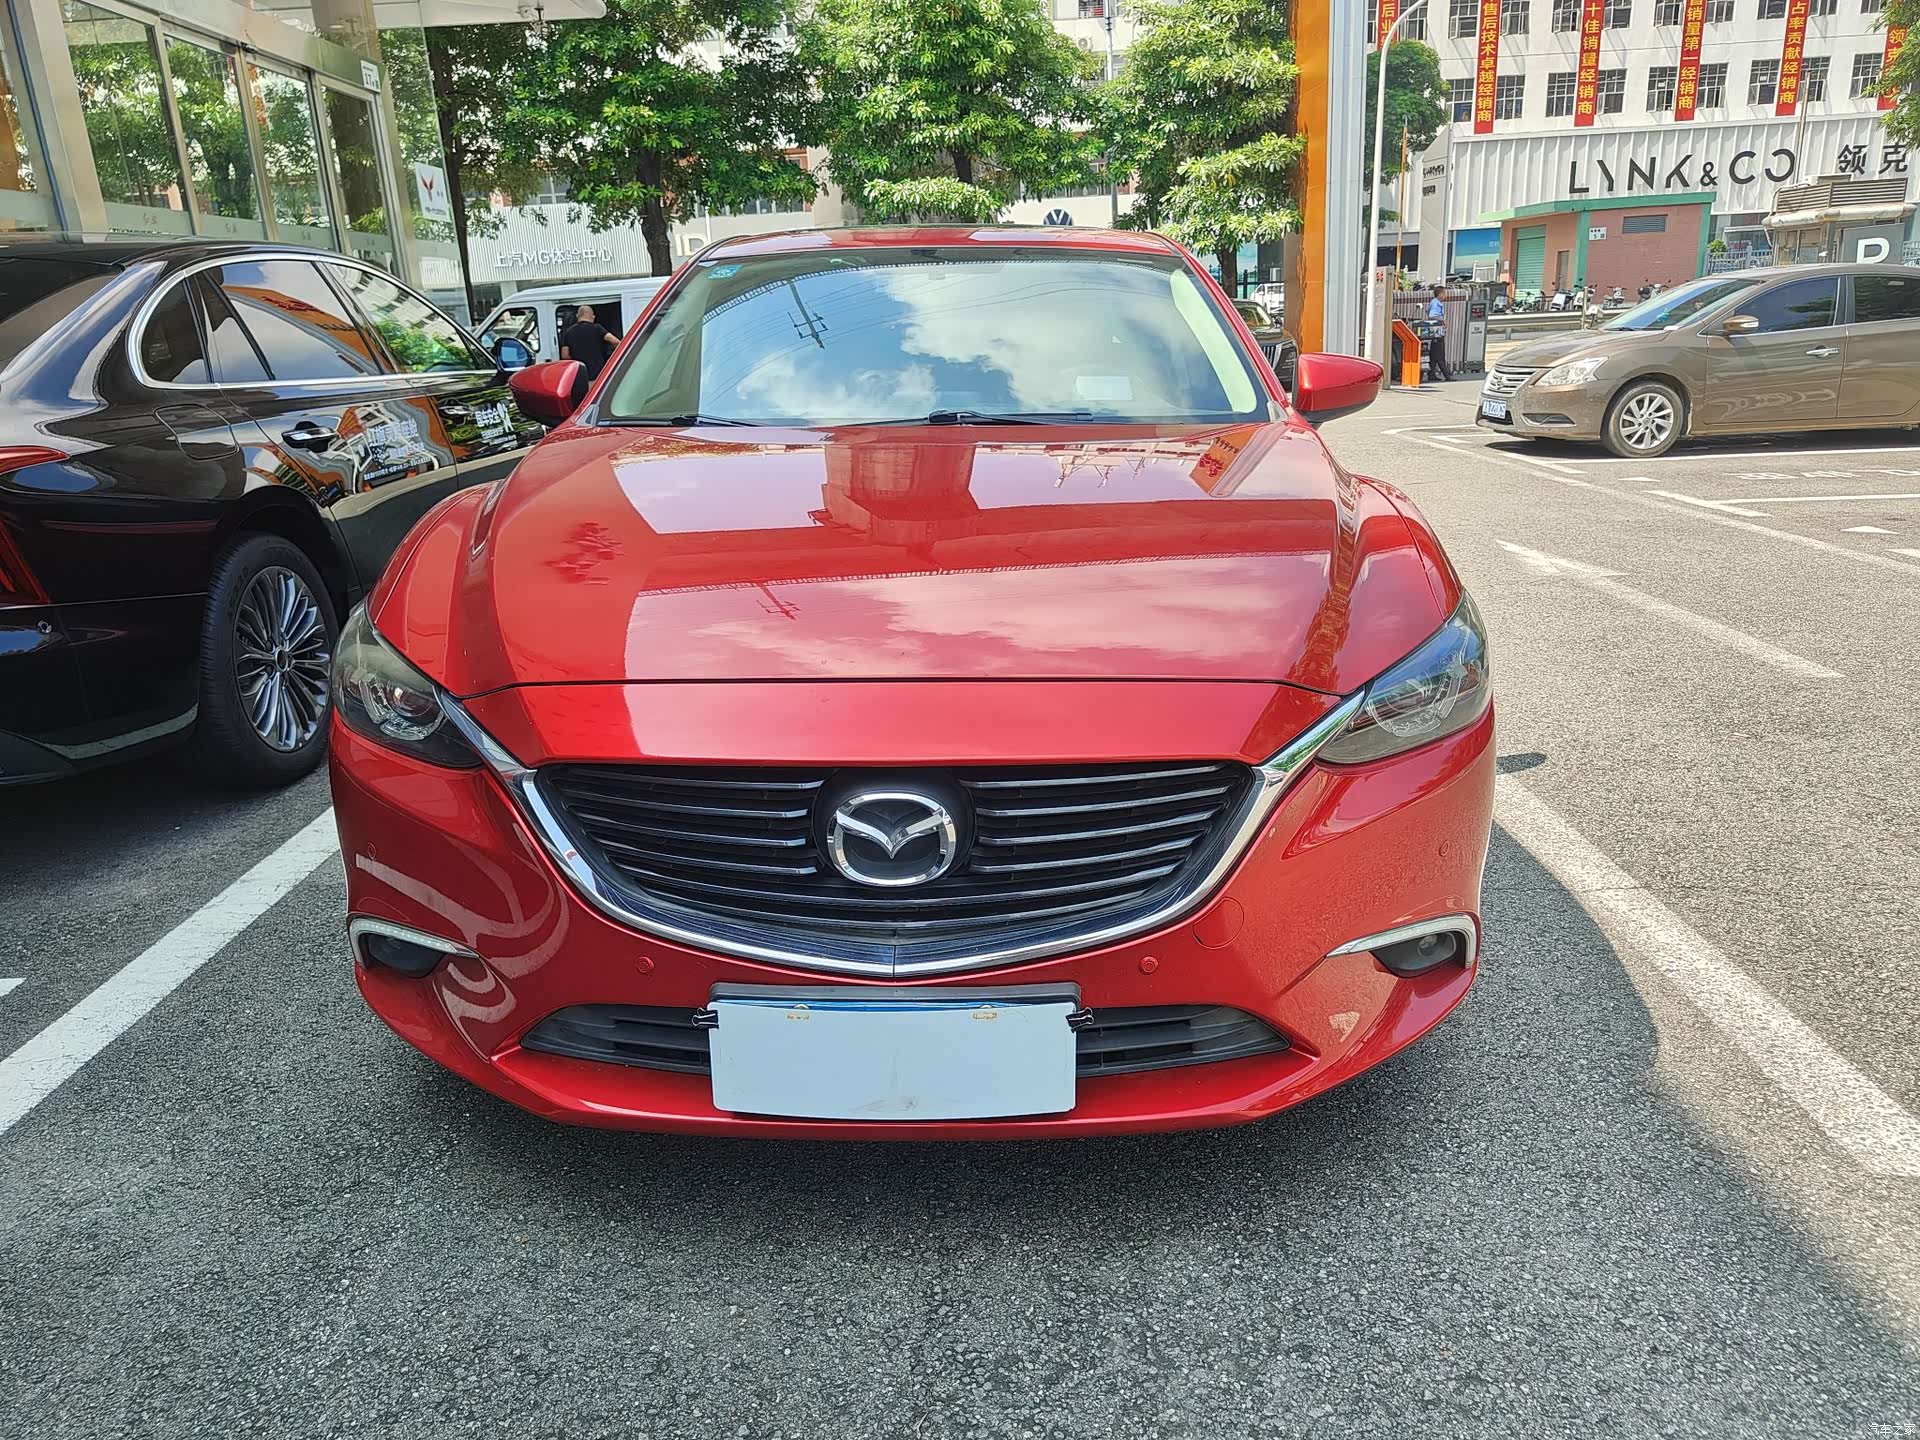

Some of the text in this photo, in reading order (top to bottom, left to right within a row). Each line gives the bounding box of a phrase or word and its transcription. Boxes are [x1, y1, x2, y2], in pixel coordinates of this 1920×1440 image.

[1477, 0, 1499, 122] 售后技术卓越经销商
[1577, 2, 1602, 115] 十佳销量经销商
[1779, 1, 1808, 105] 占率贡献经销商
[1837, 143, 1909, 175] 领克
[495, 247, 615, 268] 上汽MG体验中心
